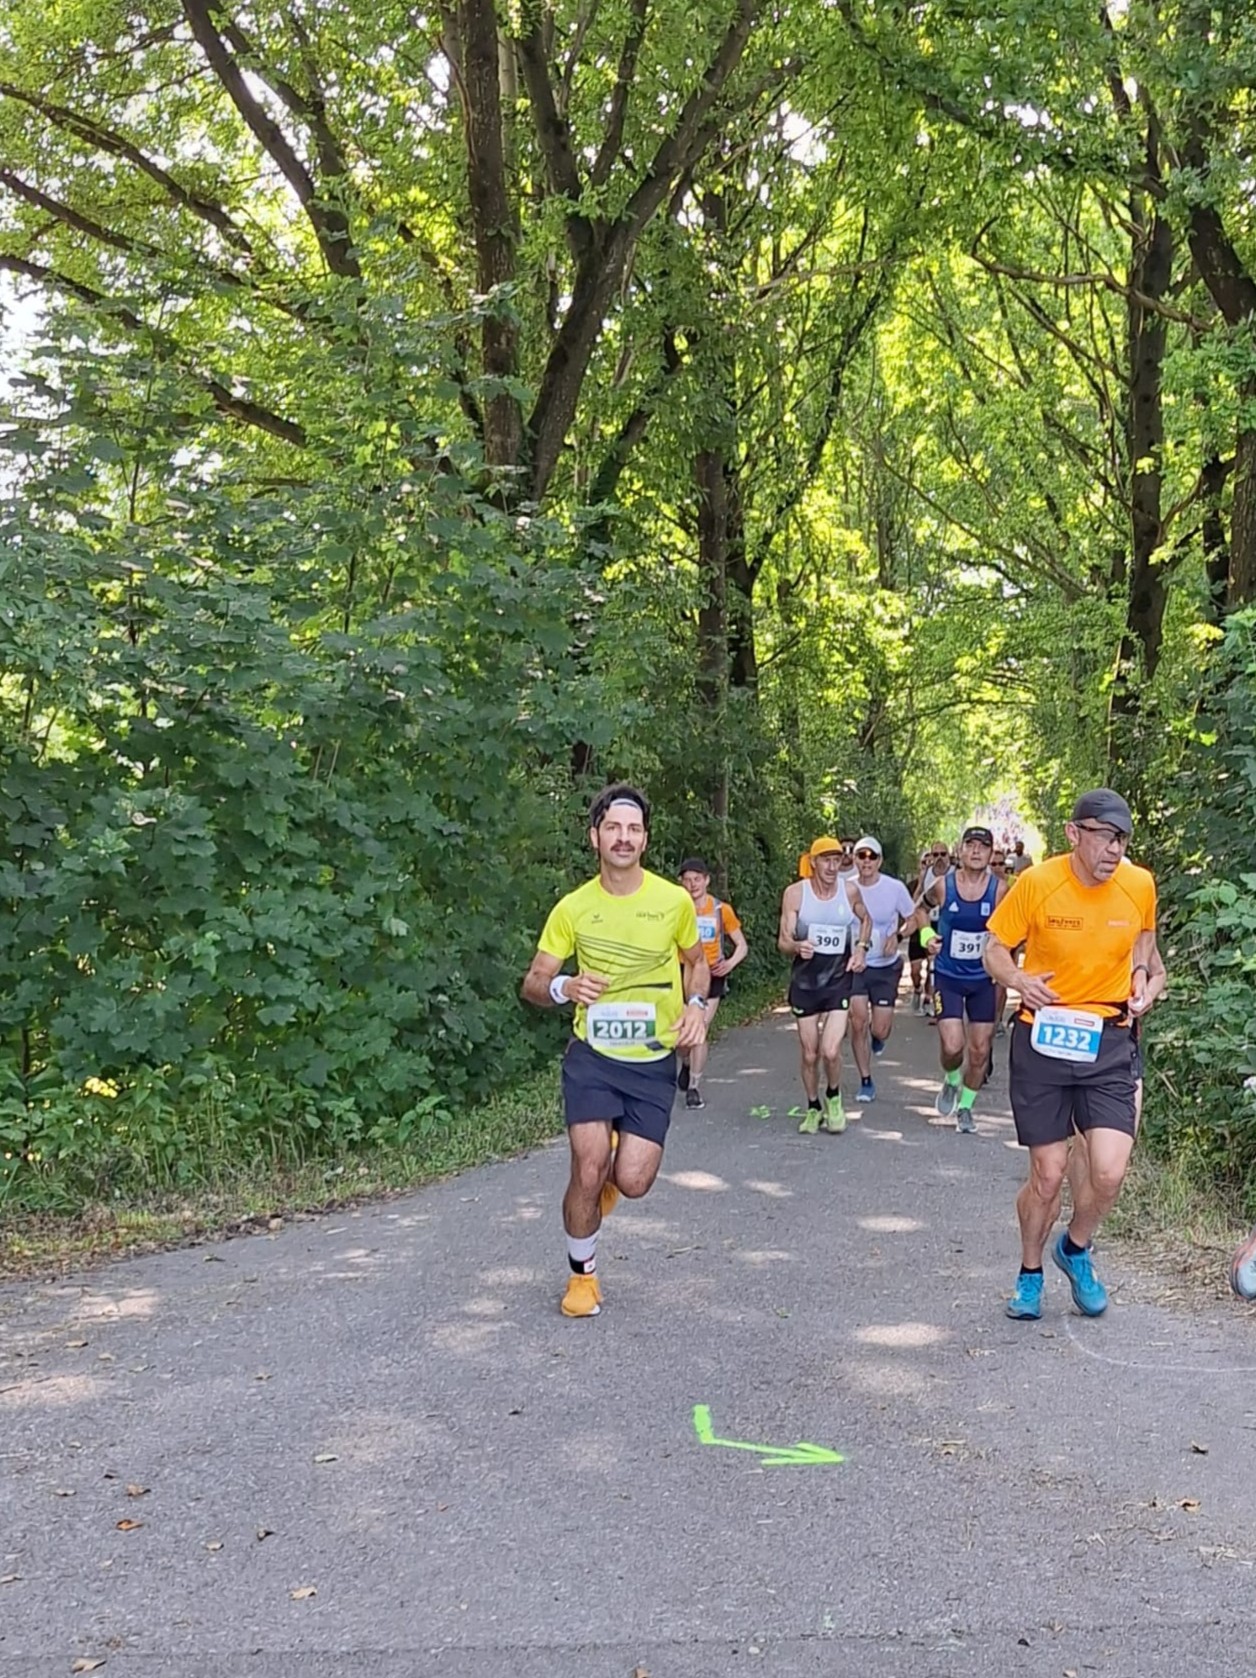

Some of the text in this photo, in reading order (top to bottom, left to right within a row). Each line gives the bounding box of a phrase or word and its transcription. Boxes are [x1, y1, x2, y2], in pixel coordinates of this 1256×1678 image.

[816, 935, 840, 947] 390
[959, 942, 981, 953] 391
[596, 1021, 647, 1038] 2012
[1043, 1025, 1091, 1051] 1232
